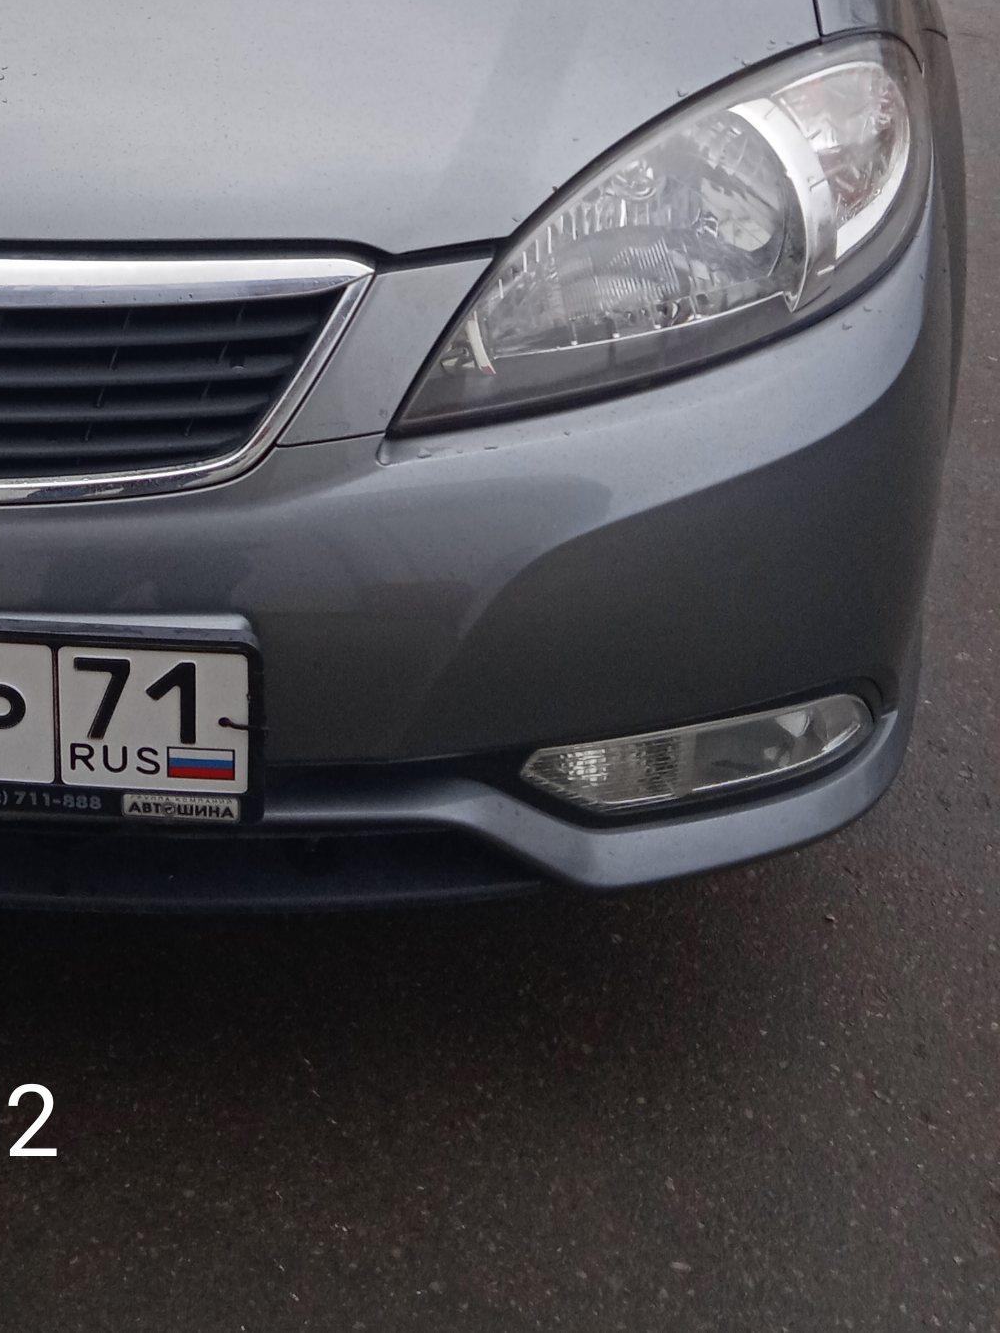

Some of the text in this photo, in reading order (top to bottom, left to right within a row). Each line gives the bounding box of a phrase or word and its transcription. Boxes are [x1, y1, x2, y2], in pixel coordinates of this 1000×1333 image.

[73, 657, 199, 744] 71
[69, 742, 161, 776] RUS
[14, 790, 102, 810] 711-888
